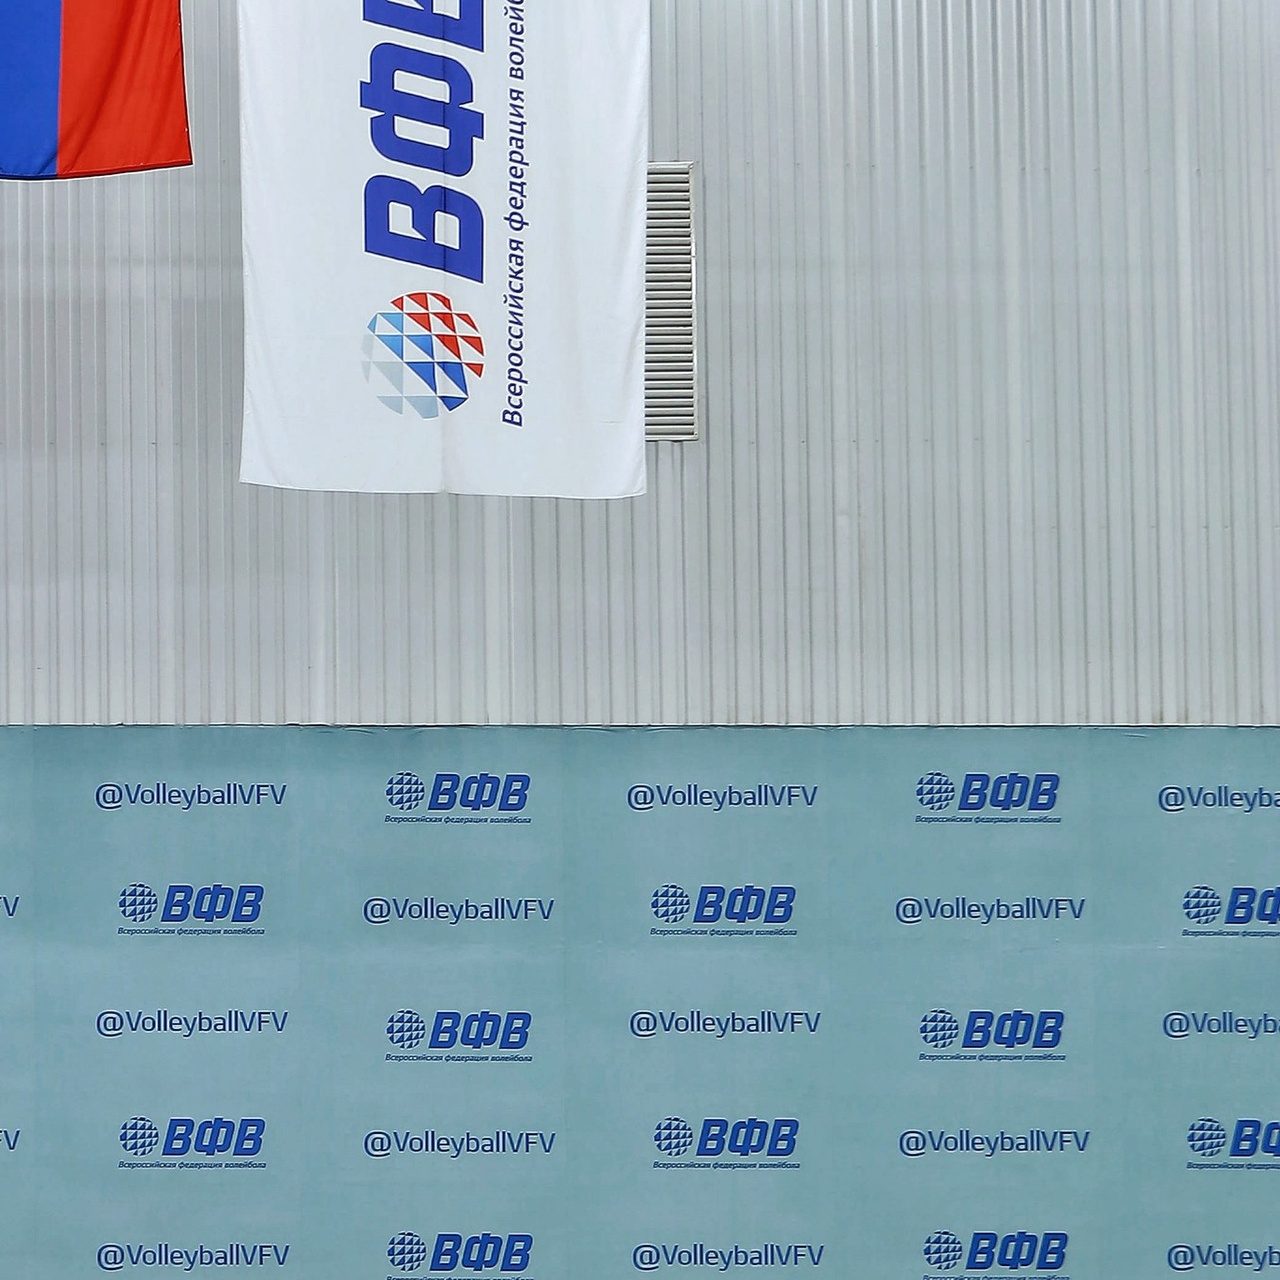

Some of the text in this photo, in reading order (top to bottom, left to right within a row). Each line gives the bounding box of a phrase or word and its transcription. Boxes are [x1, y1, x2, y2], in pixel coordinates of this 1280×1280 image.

[502, 88, 530, 232] федерация
[501, 239, 529, 427] Всероссийская
[96, 783, 286, 810] @VolleyballVFV
[427, 771, 531, 811] ВФВ
[628, 784, 818, 811] @VolleyballVFV
[957, 771, 1061, 811] ВФВ
[161, 883, 265, 924] ВФВ
[364, 898, 554, 925] @VolleyballVFV
[693, 884, 797, 923] ВФВ
[896, 897, 1085, 924] @VolleyballVFV
[97, 1009, 288, 1037] @VolleyballVFV
[428, 1009, 532, 1049] ВФВ
[630, 1011, 821, 1038] @VolleyballVFV
[961, 1009, 1065, 1048] ВФВ
[1163, 1012, 1280, 1039] @Volleyb
[162, 1116, 266, 1156] ВФВ
[364, 1129, 556, 1158] @VolleyballVFV
[696, 1117, 800, 1156] ВФВ
[900, 1130, 1090, 1157] @VolleyballVFV
[98, 1244, 289, 1271] @VolleyballVFV
[429, 1231, 534, 1271] ВФВ
[633, 1244, 824, 1271] @VolleyballVFV
[965, 1230, 1070, 1270] ВФВ
